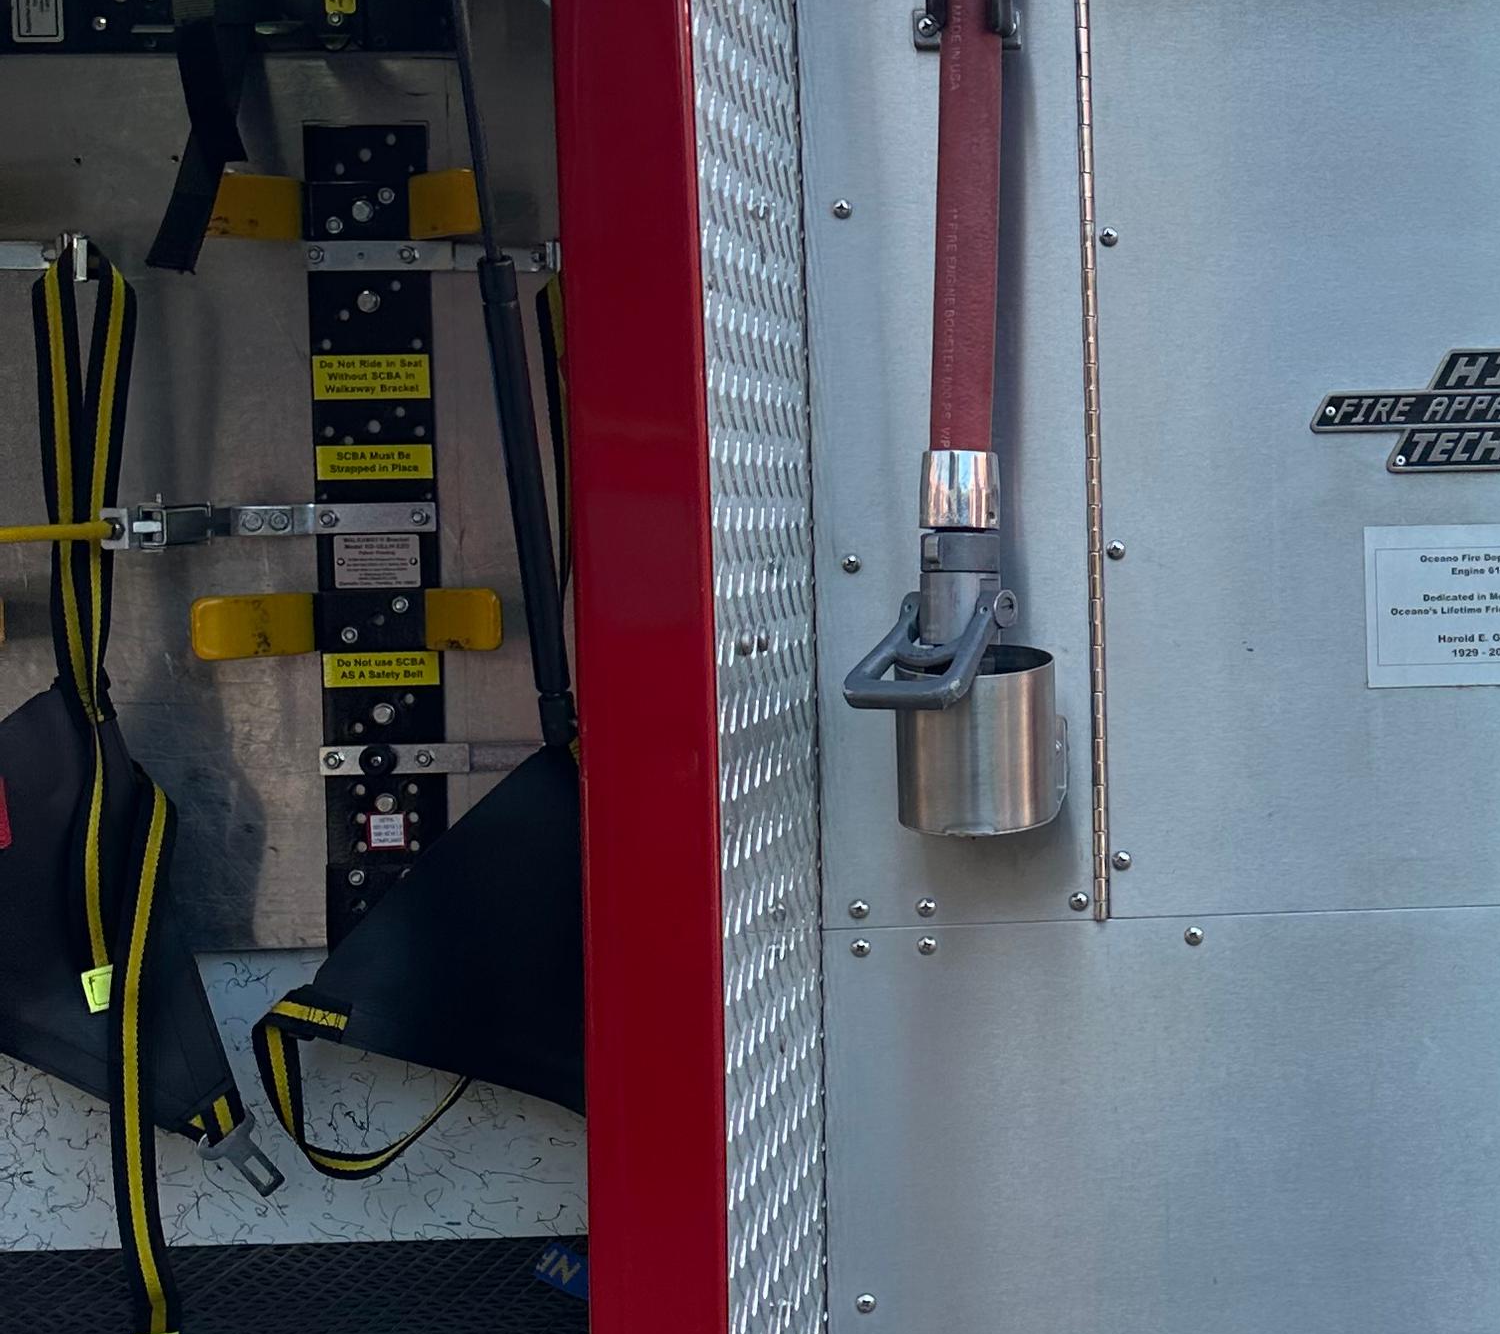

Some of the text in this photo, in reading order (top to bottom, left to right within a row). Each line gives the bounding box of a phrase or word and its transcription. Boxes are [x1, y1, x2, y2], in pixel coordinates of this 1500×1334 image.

[950, 5, 963, 44] MADE
[950, 47, 962, 61] IN
[948, 64, 962, 92] USA
[319, 360, 334, 368] Do
[337, 360, 356, 368] Not
[359, 360, 382, 368] Ride
[400, 359, 423, 367] Seat
[327, 372, 368, 380] Without
[371, 372, 402, 380] SCBA
[325, 384, 419, 394] Walkaway Bracket
[1333, 397, 1416, 423] FIRE
[336, 451, 411, 460] SCBA Must Be
[330, 464, 377, 474] Strapped
[391, 463, 419, 472] Place
[1419, 555, 1459, 563] Oceano
[1461, 554, 1481, 562] Fire
[1451, 567, 1485, 577] Engine
[1423, 593, 1475, 602] Dedicated
[1477, 593, 1487, 601] in
[1390, 607, 1439, 616] Oceano's
[1441, 606, 1483, 615] Lifetime
[1437, 634, 1475, 643] Harold
[1478, 634, 1488, 642] E.
[1451, 648, 1479, 657] 1929
[337, 659, 351, 667] Do
[354, 658, 371, 667] Not
[396, 658, 426, 666] SCBA
[341, 670, 423, 680] AS A Safety Belt
